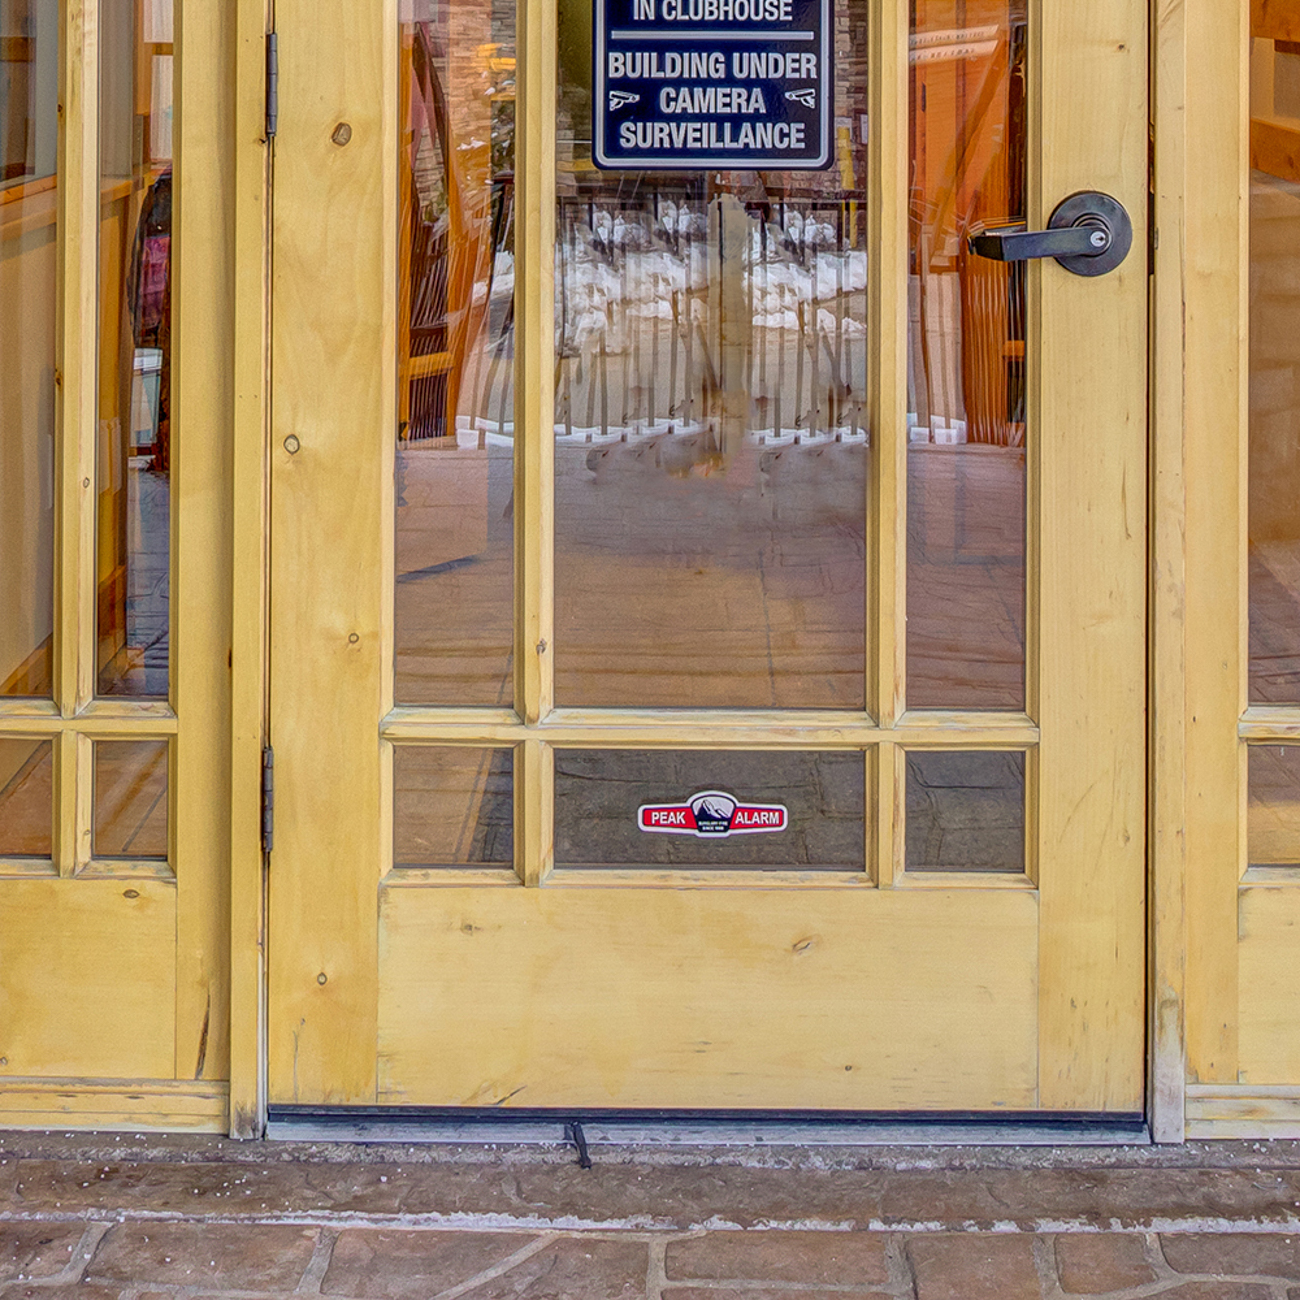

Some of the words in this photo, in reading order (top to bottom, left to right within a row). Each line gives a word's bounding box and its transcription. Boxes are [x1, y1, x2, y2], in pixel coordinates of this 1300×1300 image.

[608, 52, 725, 78] BUILDING
[732, 53, 817, 79] UNDER
[660, 88, 766, 114] CAMERA
[620, 122, 805, 149] SURVEILLANCE
[651, 812, 685, 824] PEAK
[735, 812, 779, 824] ALARM
